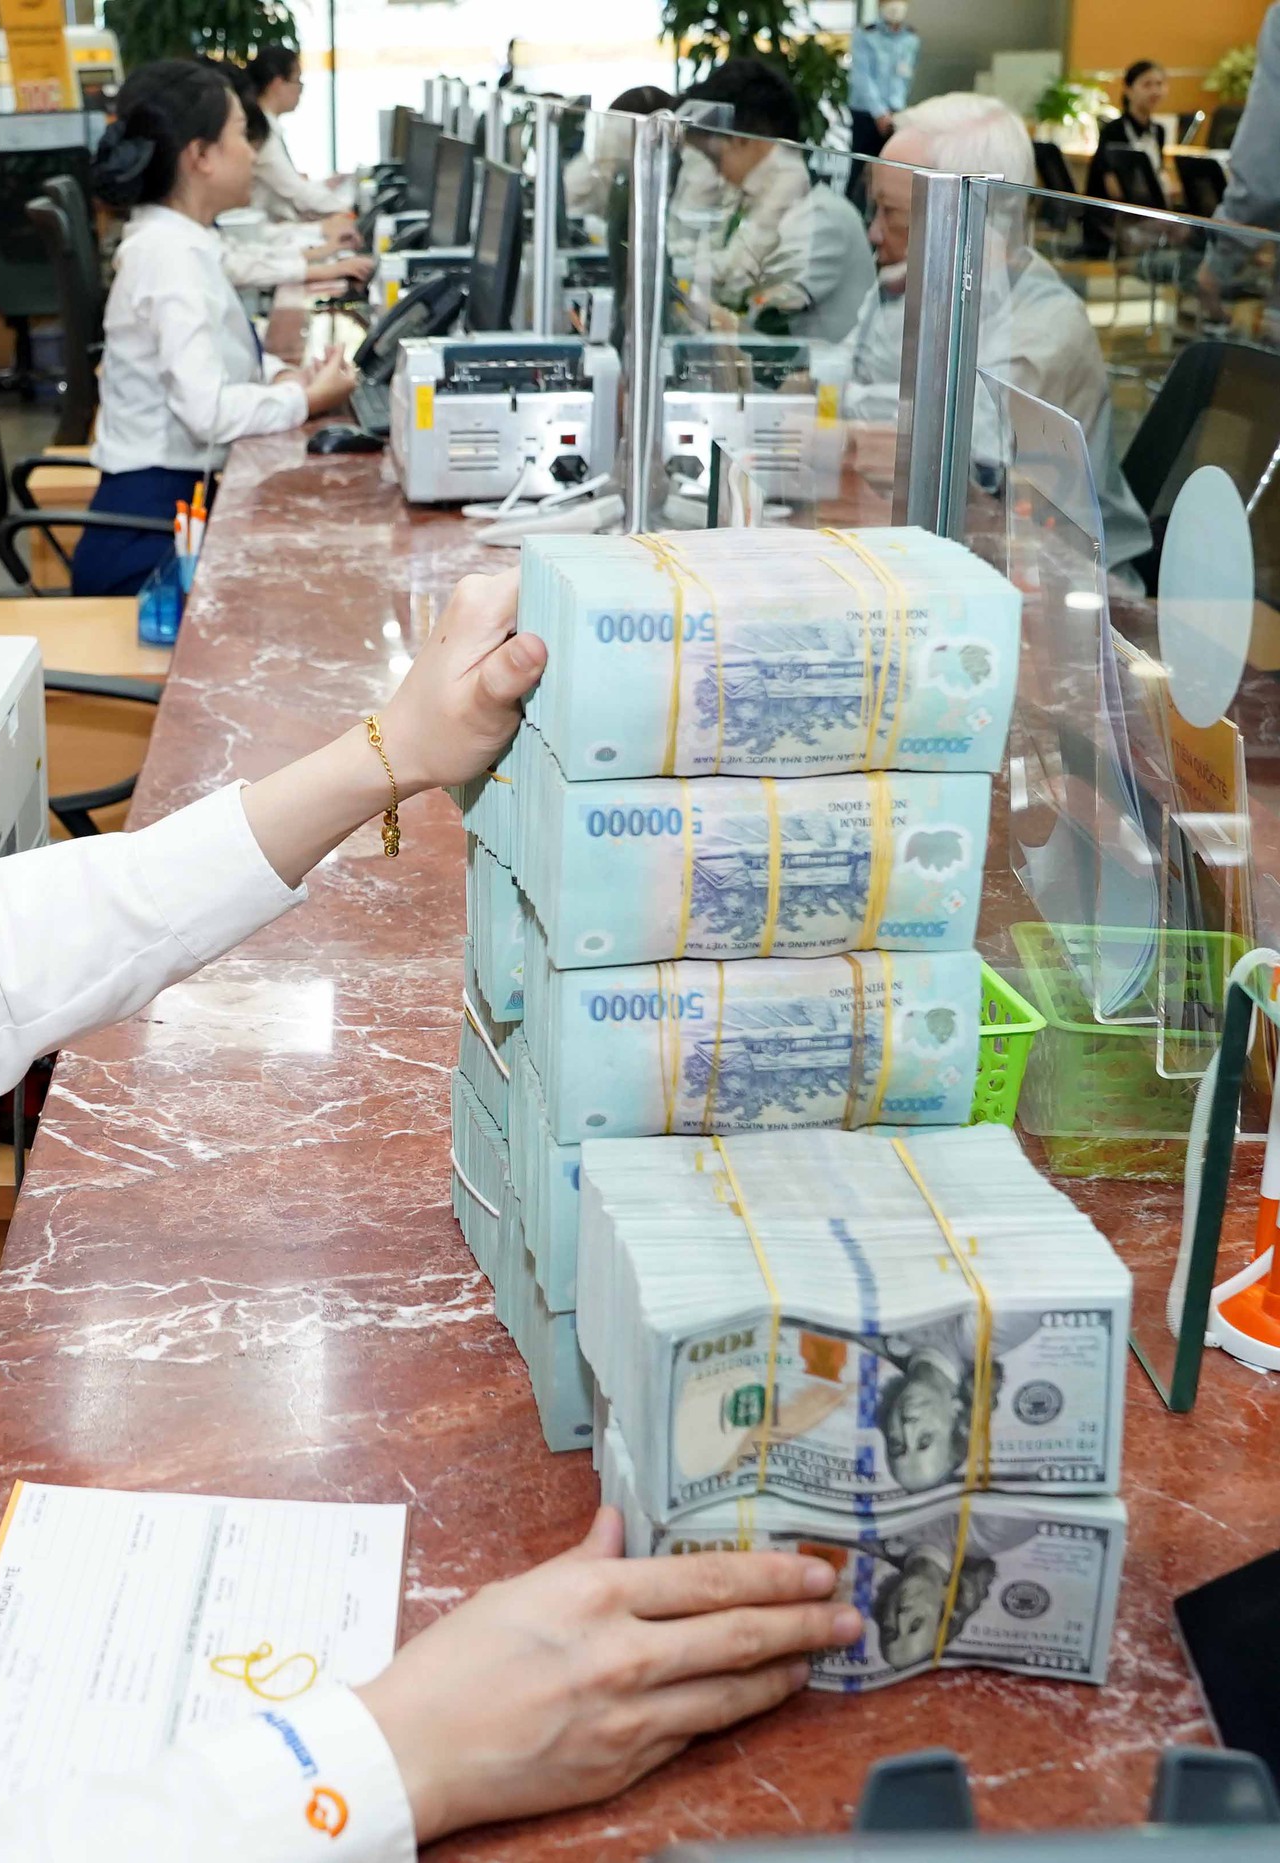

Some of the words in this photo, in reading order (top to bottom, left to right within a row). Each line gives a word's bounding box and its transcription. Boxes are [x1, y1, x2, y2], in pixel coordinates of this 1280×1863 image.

[596, 612, 716, 643] 500000
[588, 806, 702, 837] 500000
[589, 992, 704, 1021] 500000
